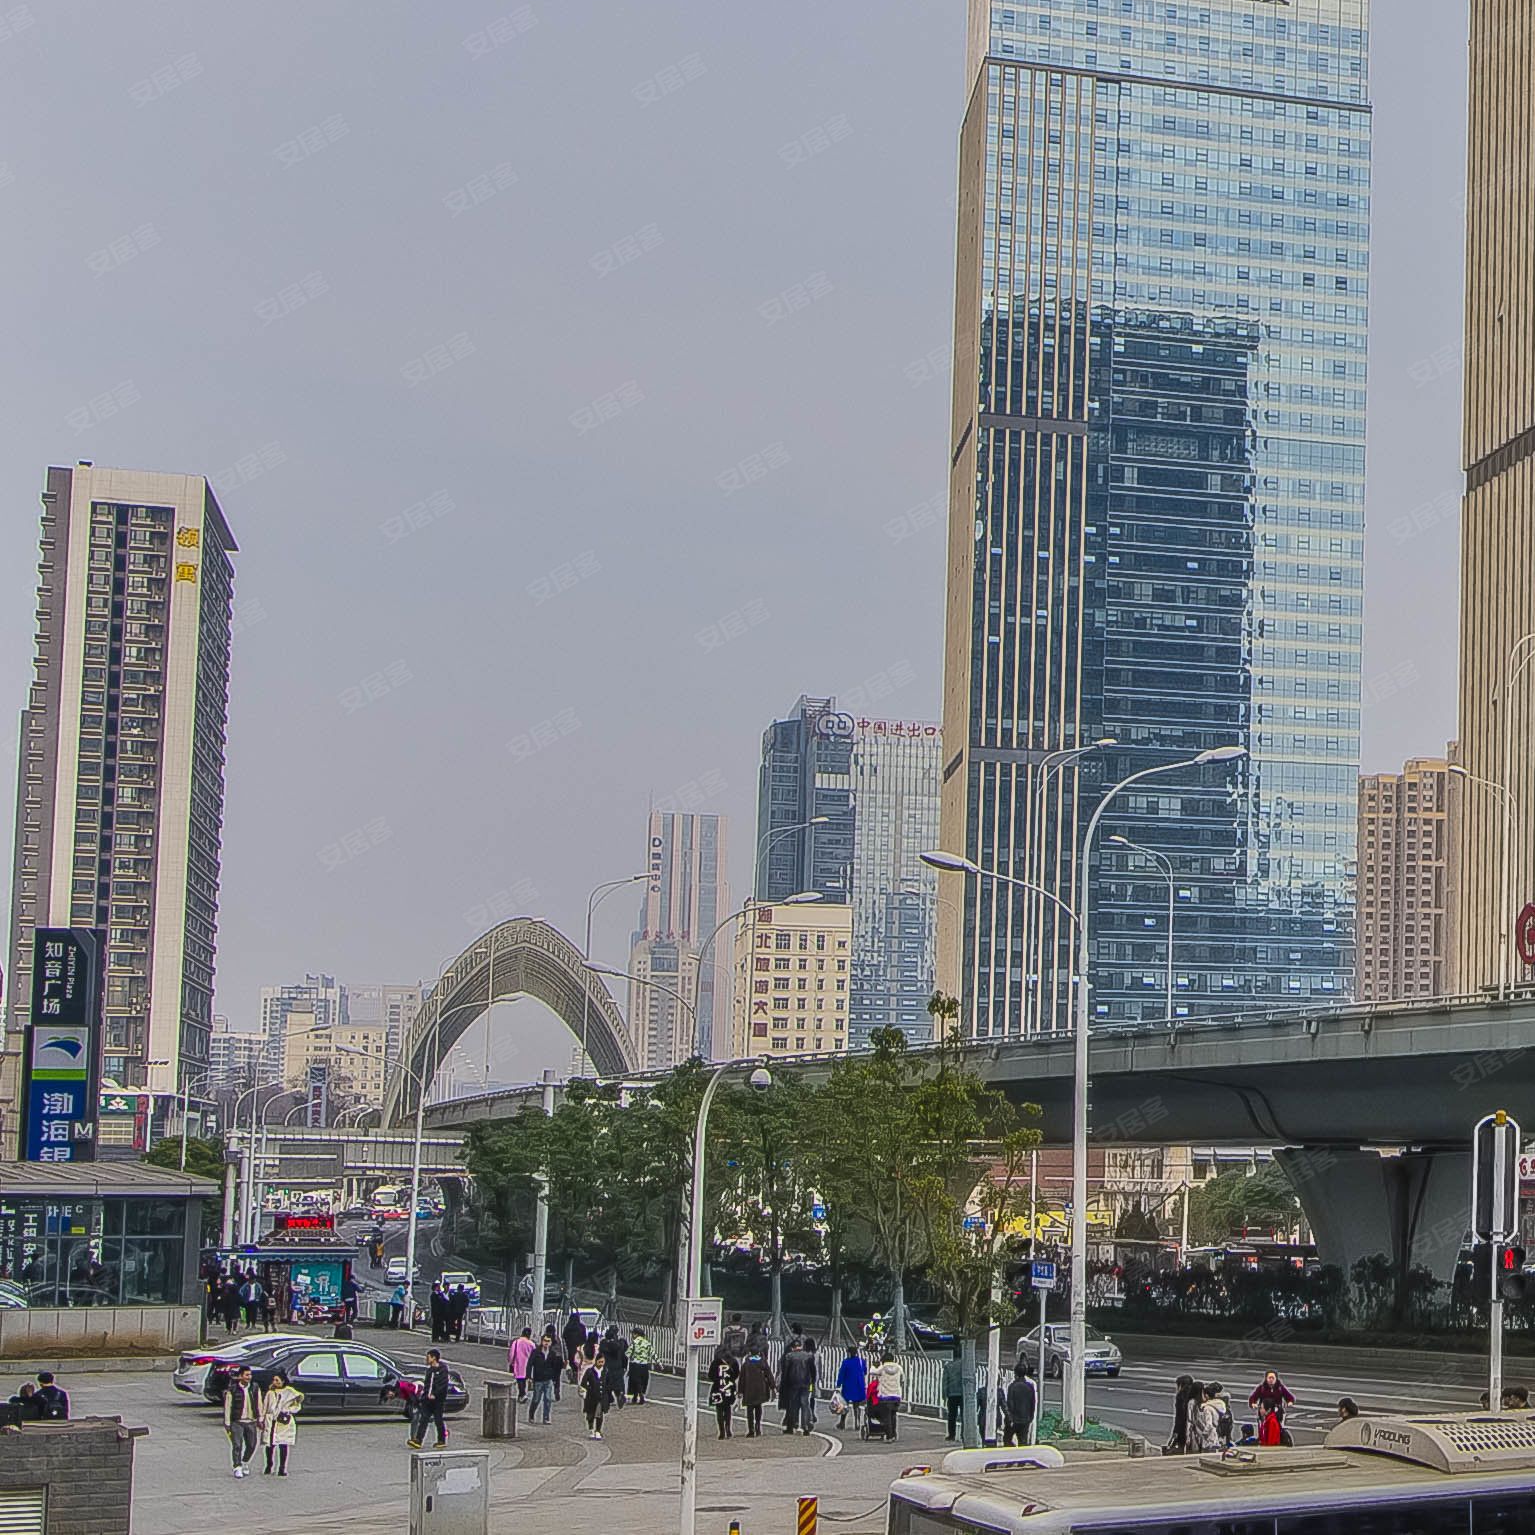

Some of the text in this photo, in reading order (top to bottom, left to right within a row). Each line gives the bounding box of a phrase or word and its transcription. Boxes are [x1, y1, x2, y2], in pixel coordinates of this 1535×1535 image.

[856, 717, 945, 738] 中国进出口
[42, 941, 63, 1014] 知音广场
